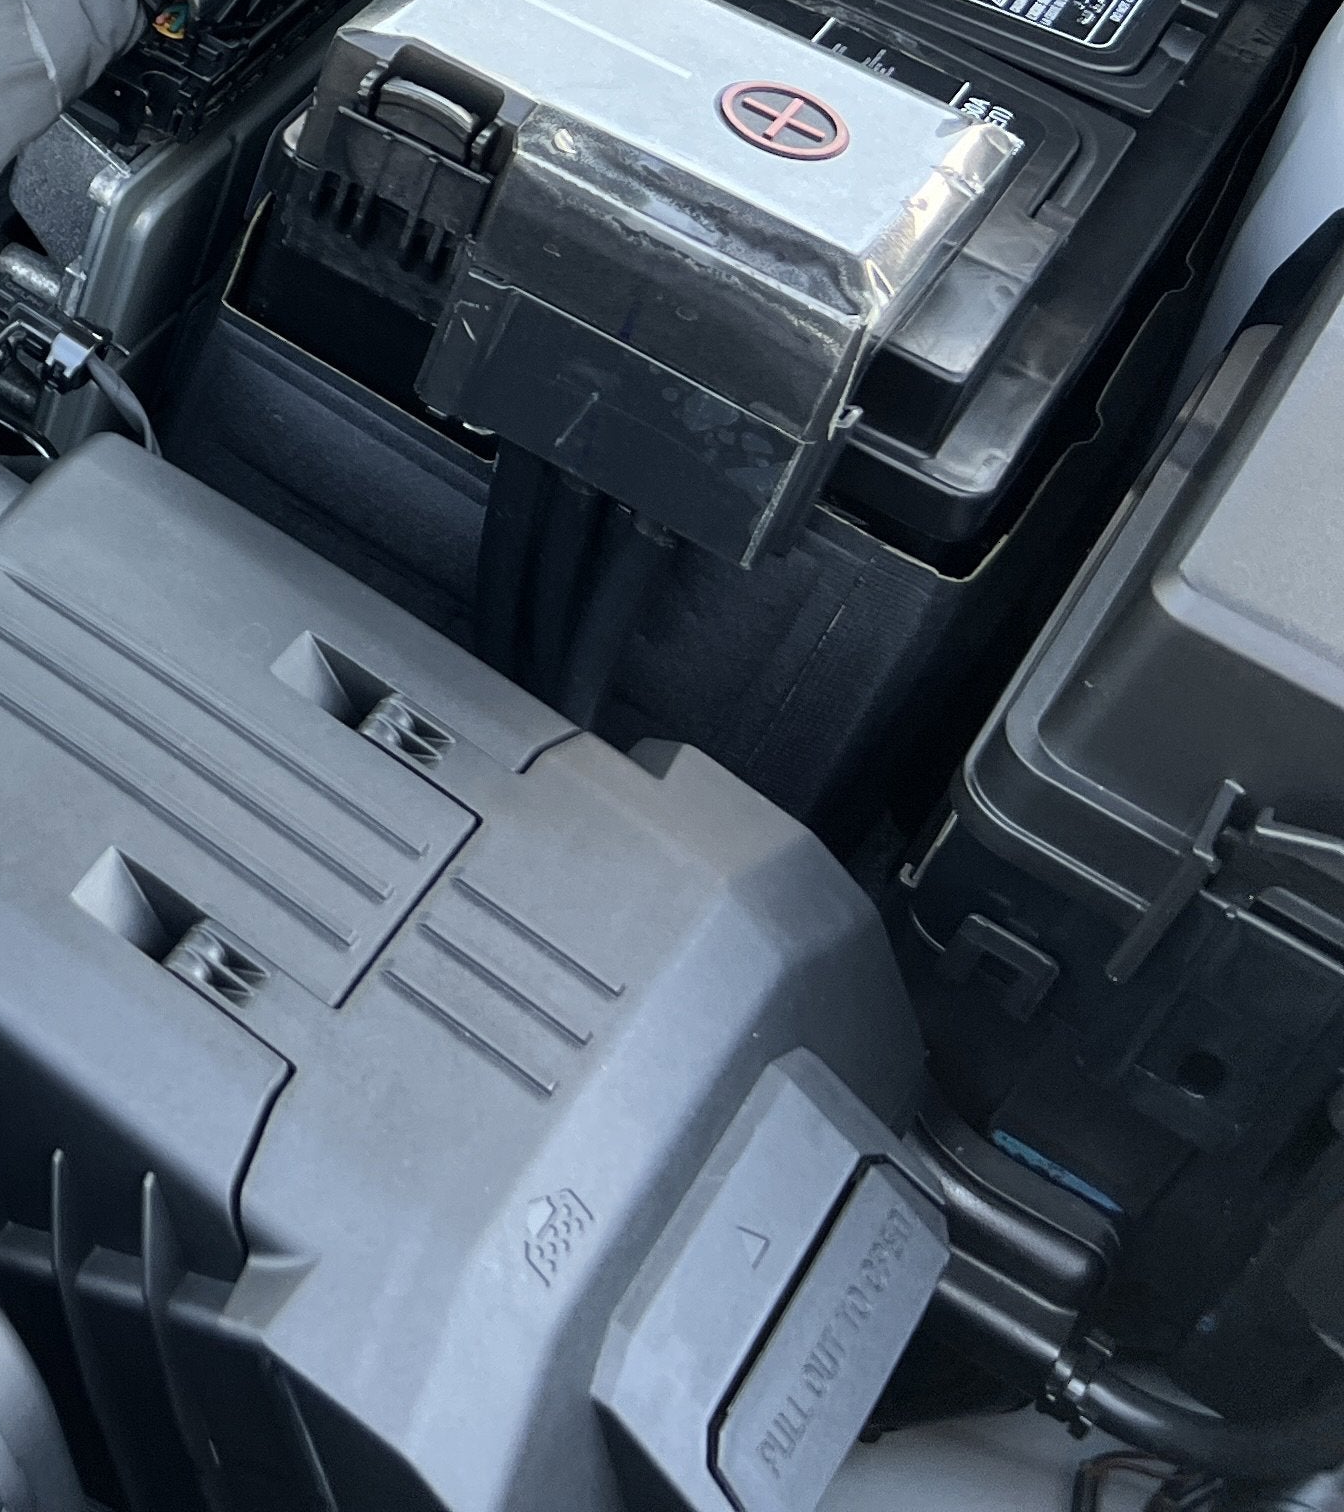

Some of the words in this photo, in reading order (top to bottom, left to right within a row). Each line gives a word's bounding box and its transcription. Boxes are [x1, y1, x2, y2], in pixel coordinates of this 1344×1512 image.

[756, 1395, 810, 1480] PULL
[801, 1322, 846, 1399] OUT
[834, 1284, 874, 1334] TO
